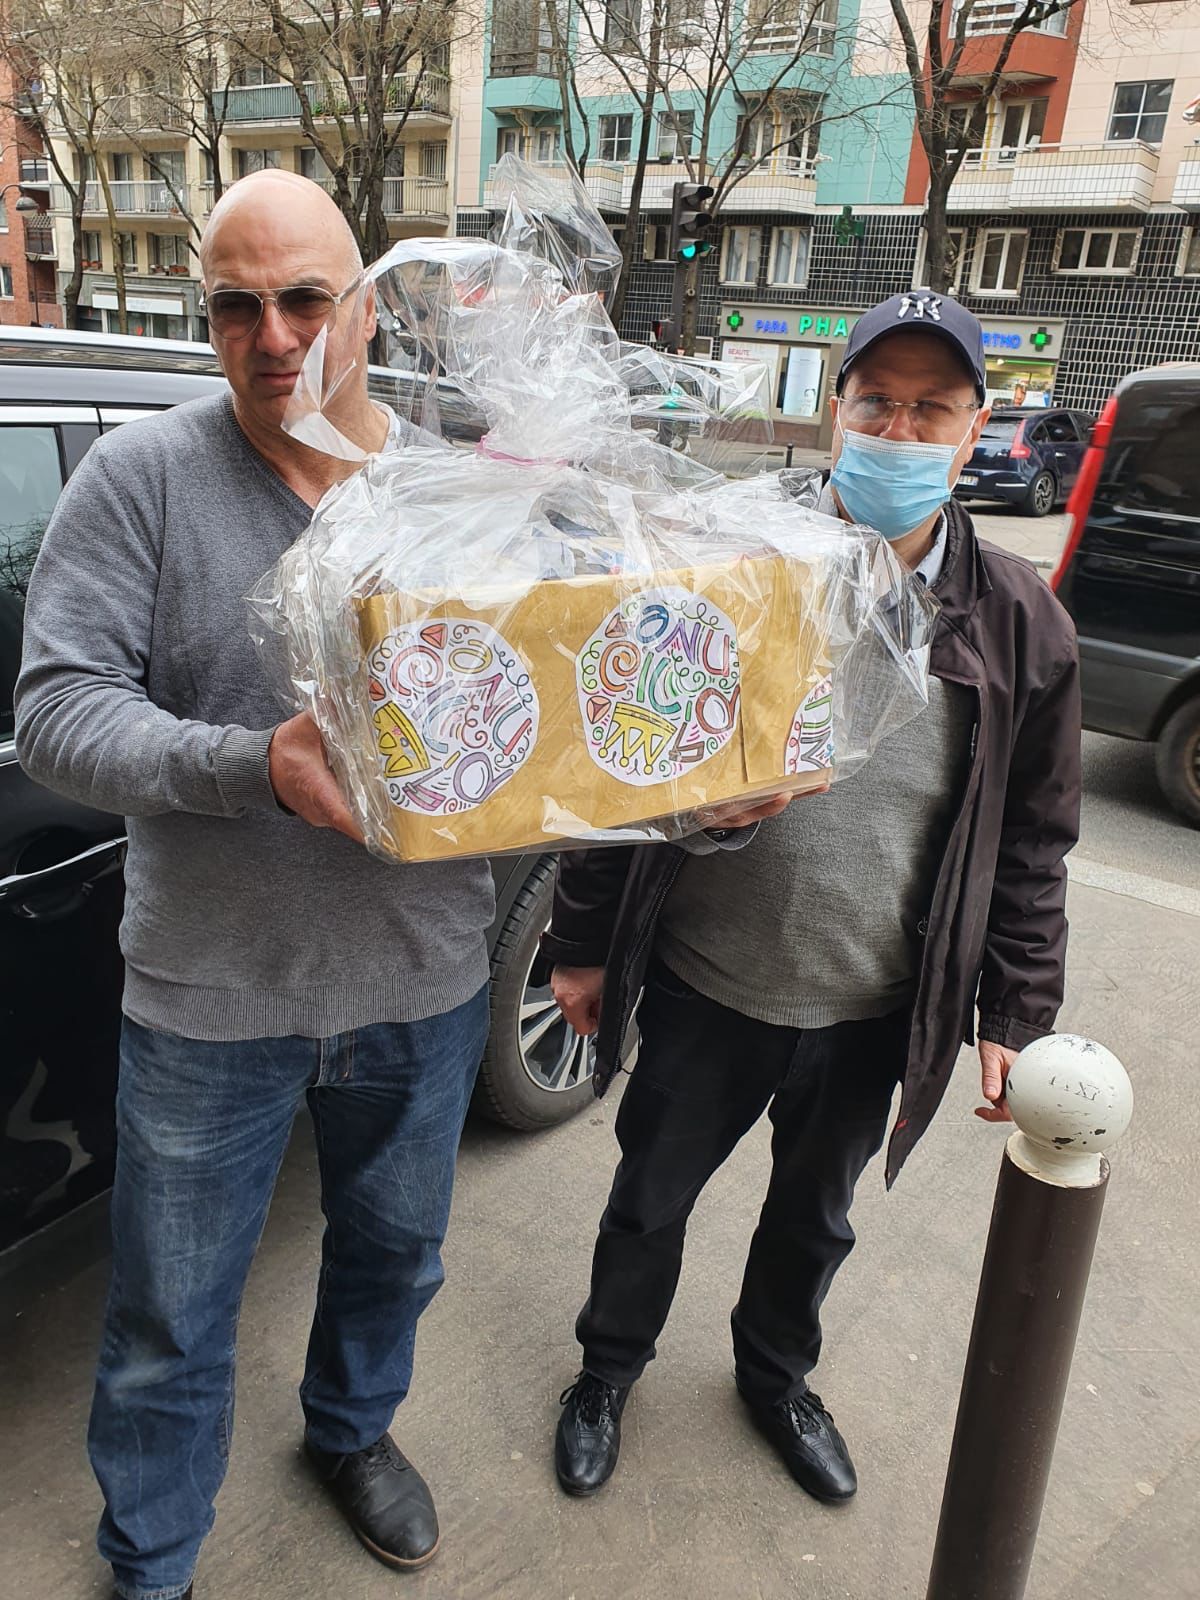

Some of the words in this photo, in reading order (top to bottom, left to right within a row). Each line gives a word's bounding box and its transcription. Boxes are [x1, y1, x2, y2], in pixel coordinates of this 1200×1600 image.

[754, 319, 788, 335] PARA
[799, 314, 858, 337] PHA
[981, 331, 1023, 350] RTHO
